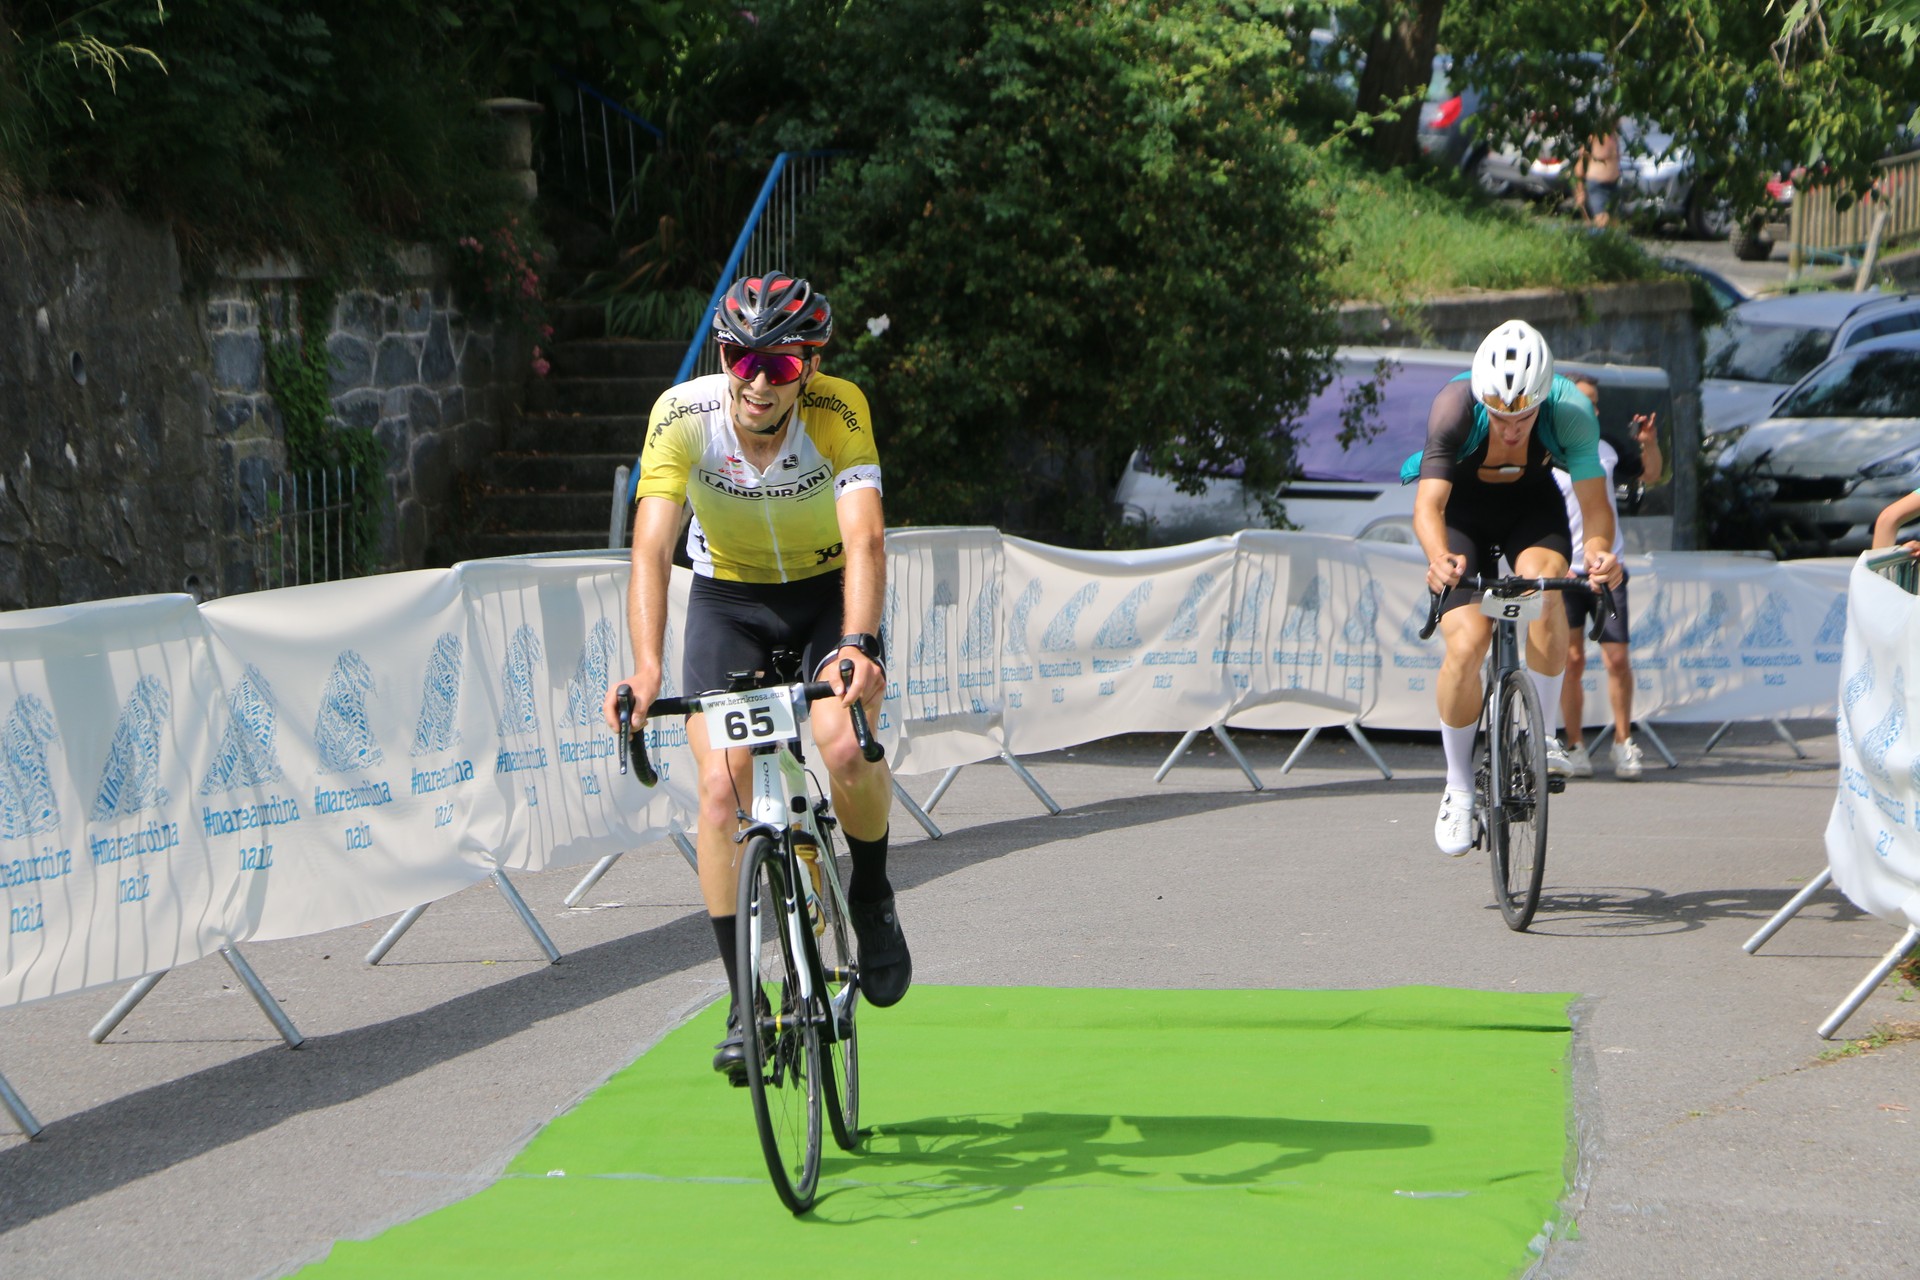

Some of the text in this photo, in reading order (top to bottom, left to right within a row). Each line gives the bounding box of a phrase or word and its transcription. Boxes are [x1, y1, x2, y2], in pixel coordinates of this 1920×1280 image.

[807, 392, 861, 432] Santander
[1503, 604, 1520, 617] 8
[725, 706, 774, 741] 65
[203, 794, 301, 838] #mareaurdina
[90, 820, 180, 867] #mareaurdina
[345, 820, 373, 852] naiz
[119, 867, 150, 904] naiz
[10, 898, 44, 934] naiz
